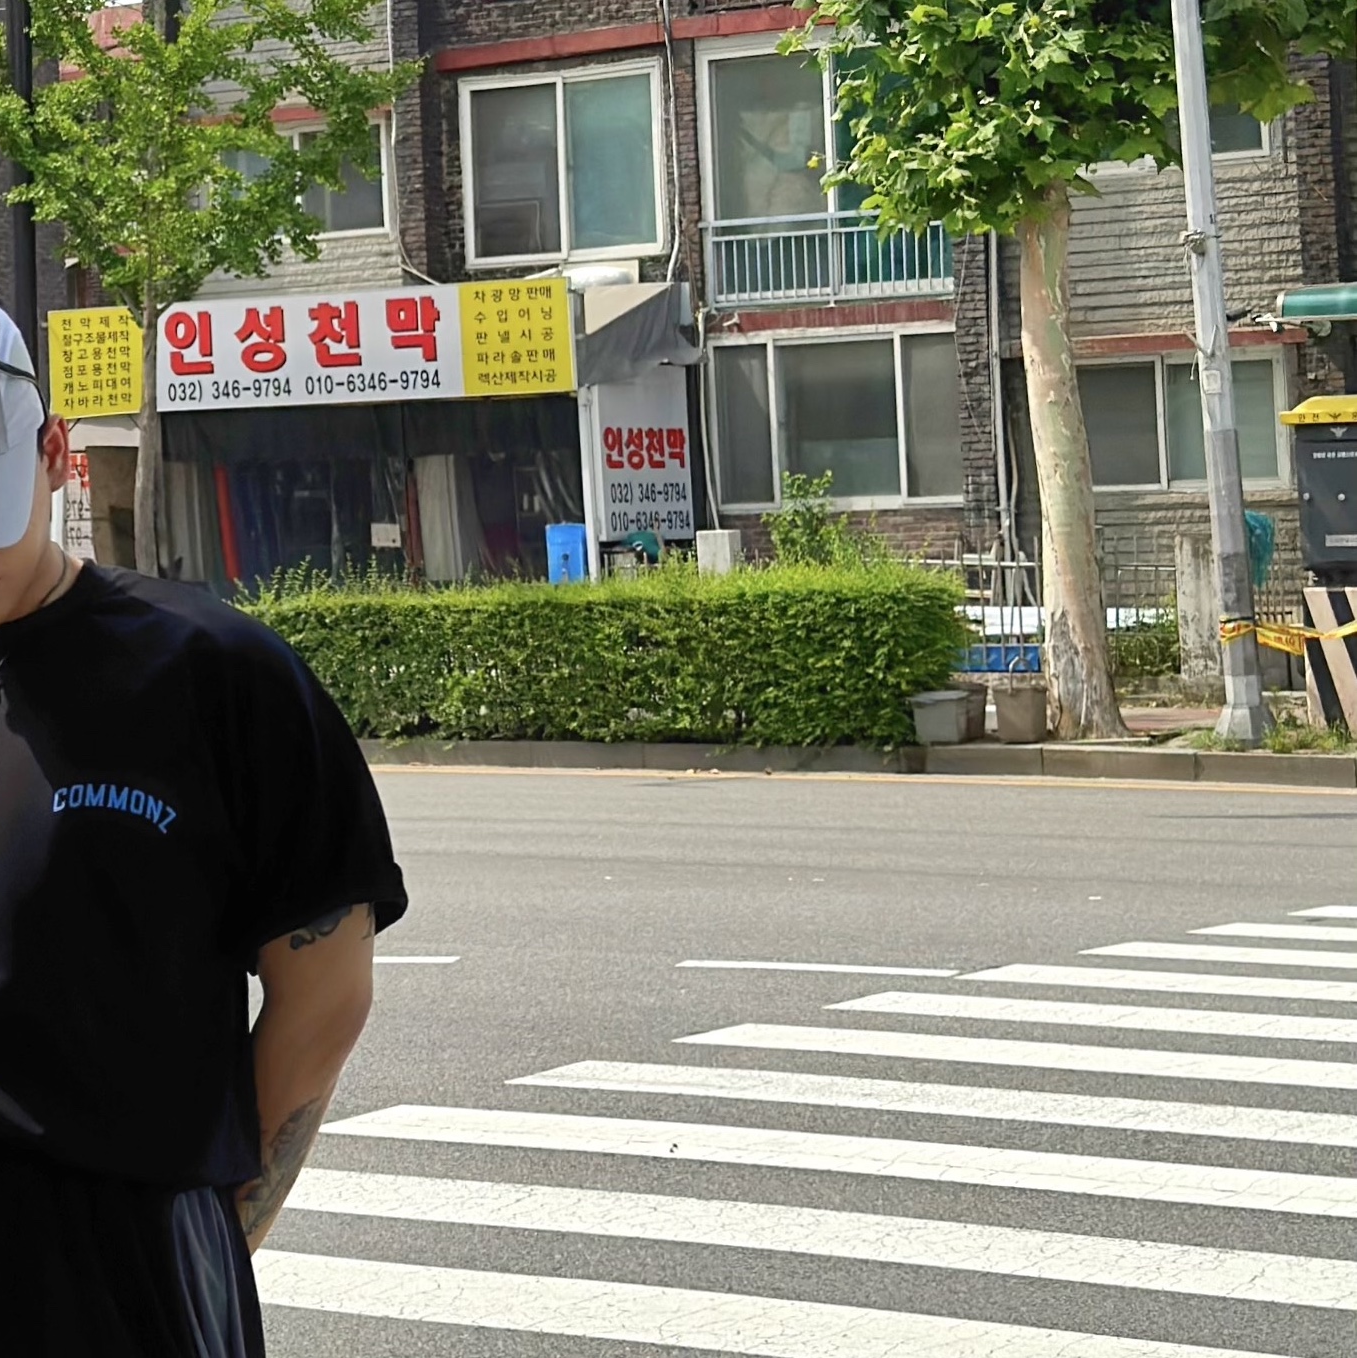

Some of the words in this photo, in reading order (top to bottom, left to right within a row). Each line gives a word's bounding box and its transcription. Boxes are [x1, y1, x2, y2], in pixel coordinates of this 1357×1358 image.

[164, 296, 440, 376] 인성천막
[168, 381, 204, 403] 032)
[212, 377, 292, 400] 346-9794
[305, 369, 441, 396] 010-6346-9794
[603, 426, 686, 470] 인성천막
[611, 481, 633, 505] 032)
[638, 482, 687, 503] 346-9794
[611, 510, 691, 532] 010-6346-9794
[53, 783, 177, 834] COMMONZ
